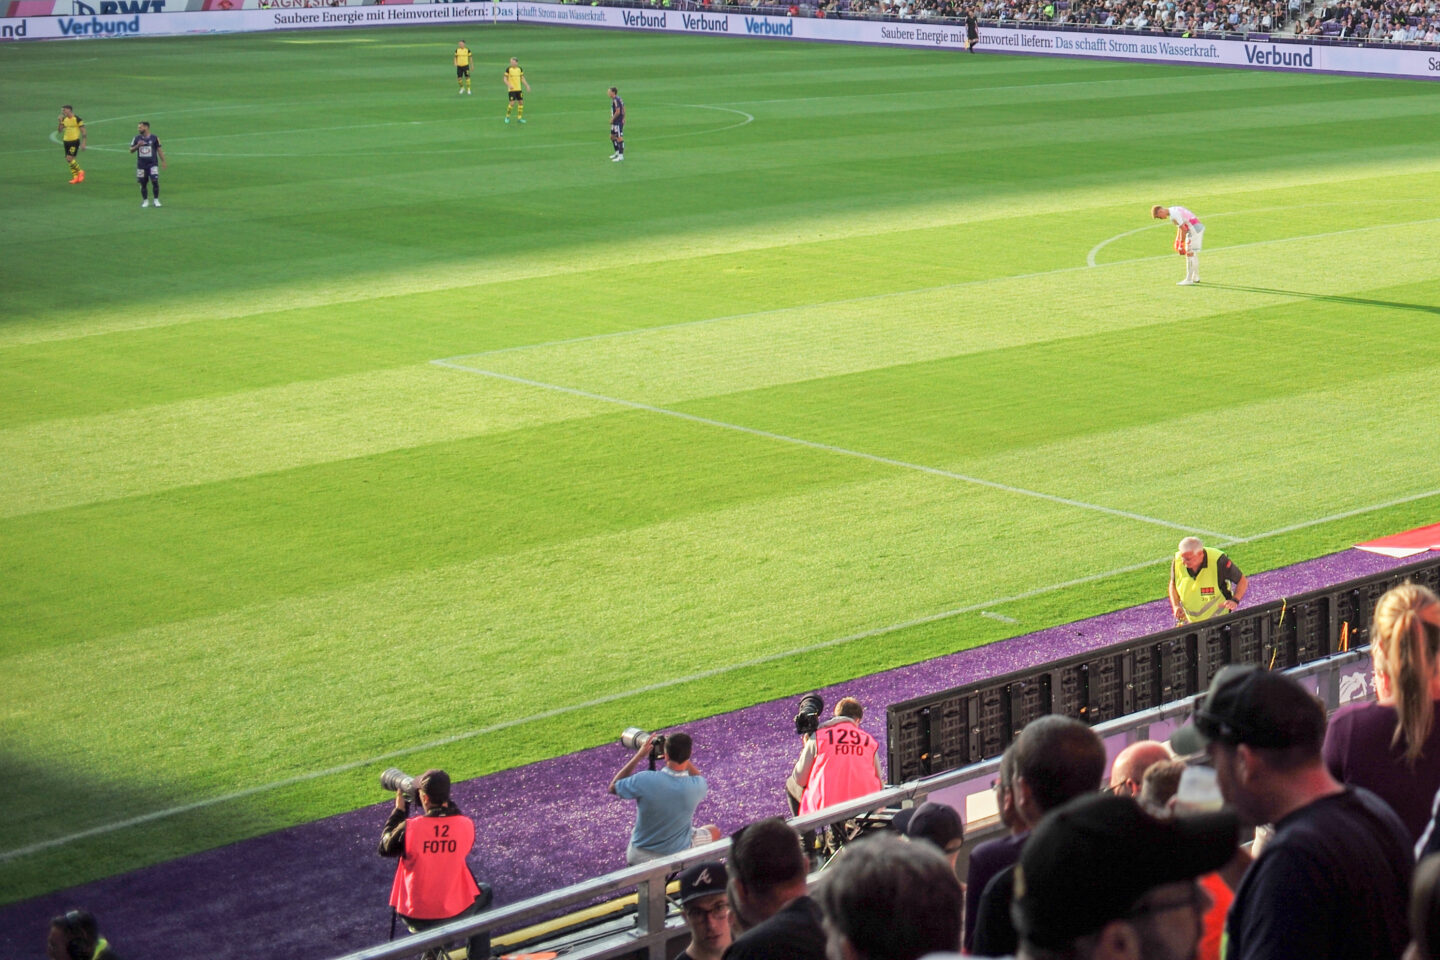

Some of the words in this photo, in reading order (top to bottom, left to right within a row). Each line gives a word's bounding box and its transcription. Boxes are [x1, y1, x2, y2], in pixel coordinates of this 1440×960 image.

[274, 12, 320, 24] Saubere
[322, 11, 364, 24] Energie
[366, 10, 385, 20] mit
[387, 8, 450, 20] Heimvorteil
[452, 6, 489, 18] liefern:
[492, 6, 514, 16] Das
[622, 10, 666, 28] Verbund
[682, 13, 728, 32] Verbund
[58, 15, 140, 35] Verbund
[745, 16, 793, 36] Verbund
[881, 26, 914, 40] Saubere
[916, 28, 949, 44] Energie
[950, 30, 965, 42] mit
[1020, 35, 1053, 48] liefern:
[1055, 36, 1074, 49] Das
[1075, 38, 1107, 51] schafft
[1109, 40, 1138, 52] Strom
[1140, 44, 1157, 54] aus
[1158, 42, 1220, 58] Wasserkraft.
[1244, 44, 1312, 67] Verbund
[835, 744, 864, 756] FOTO
[434, 824, 450, 838] 12
[423, 840, 456, 854] FOTO
